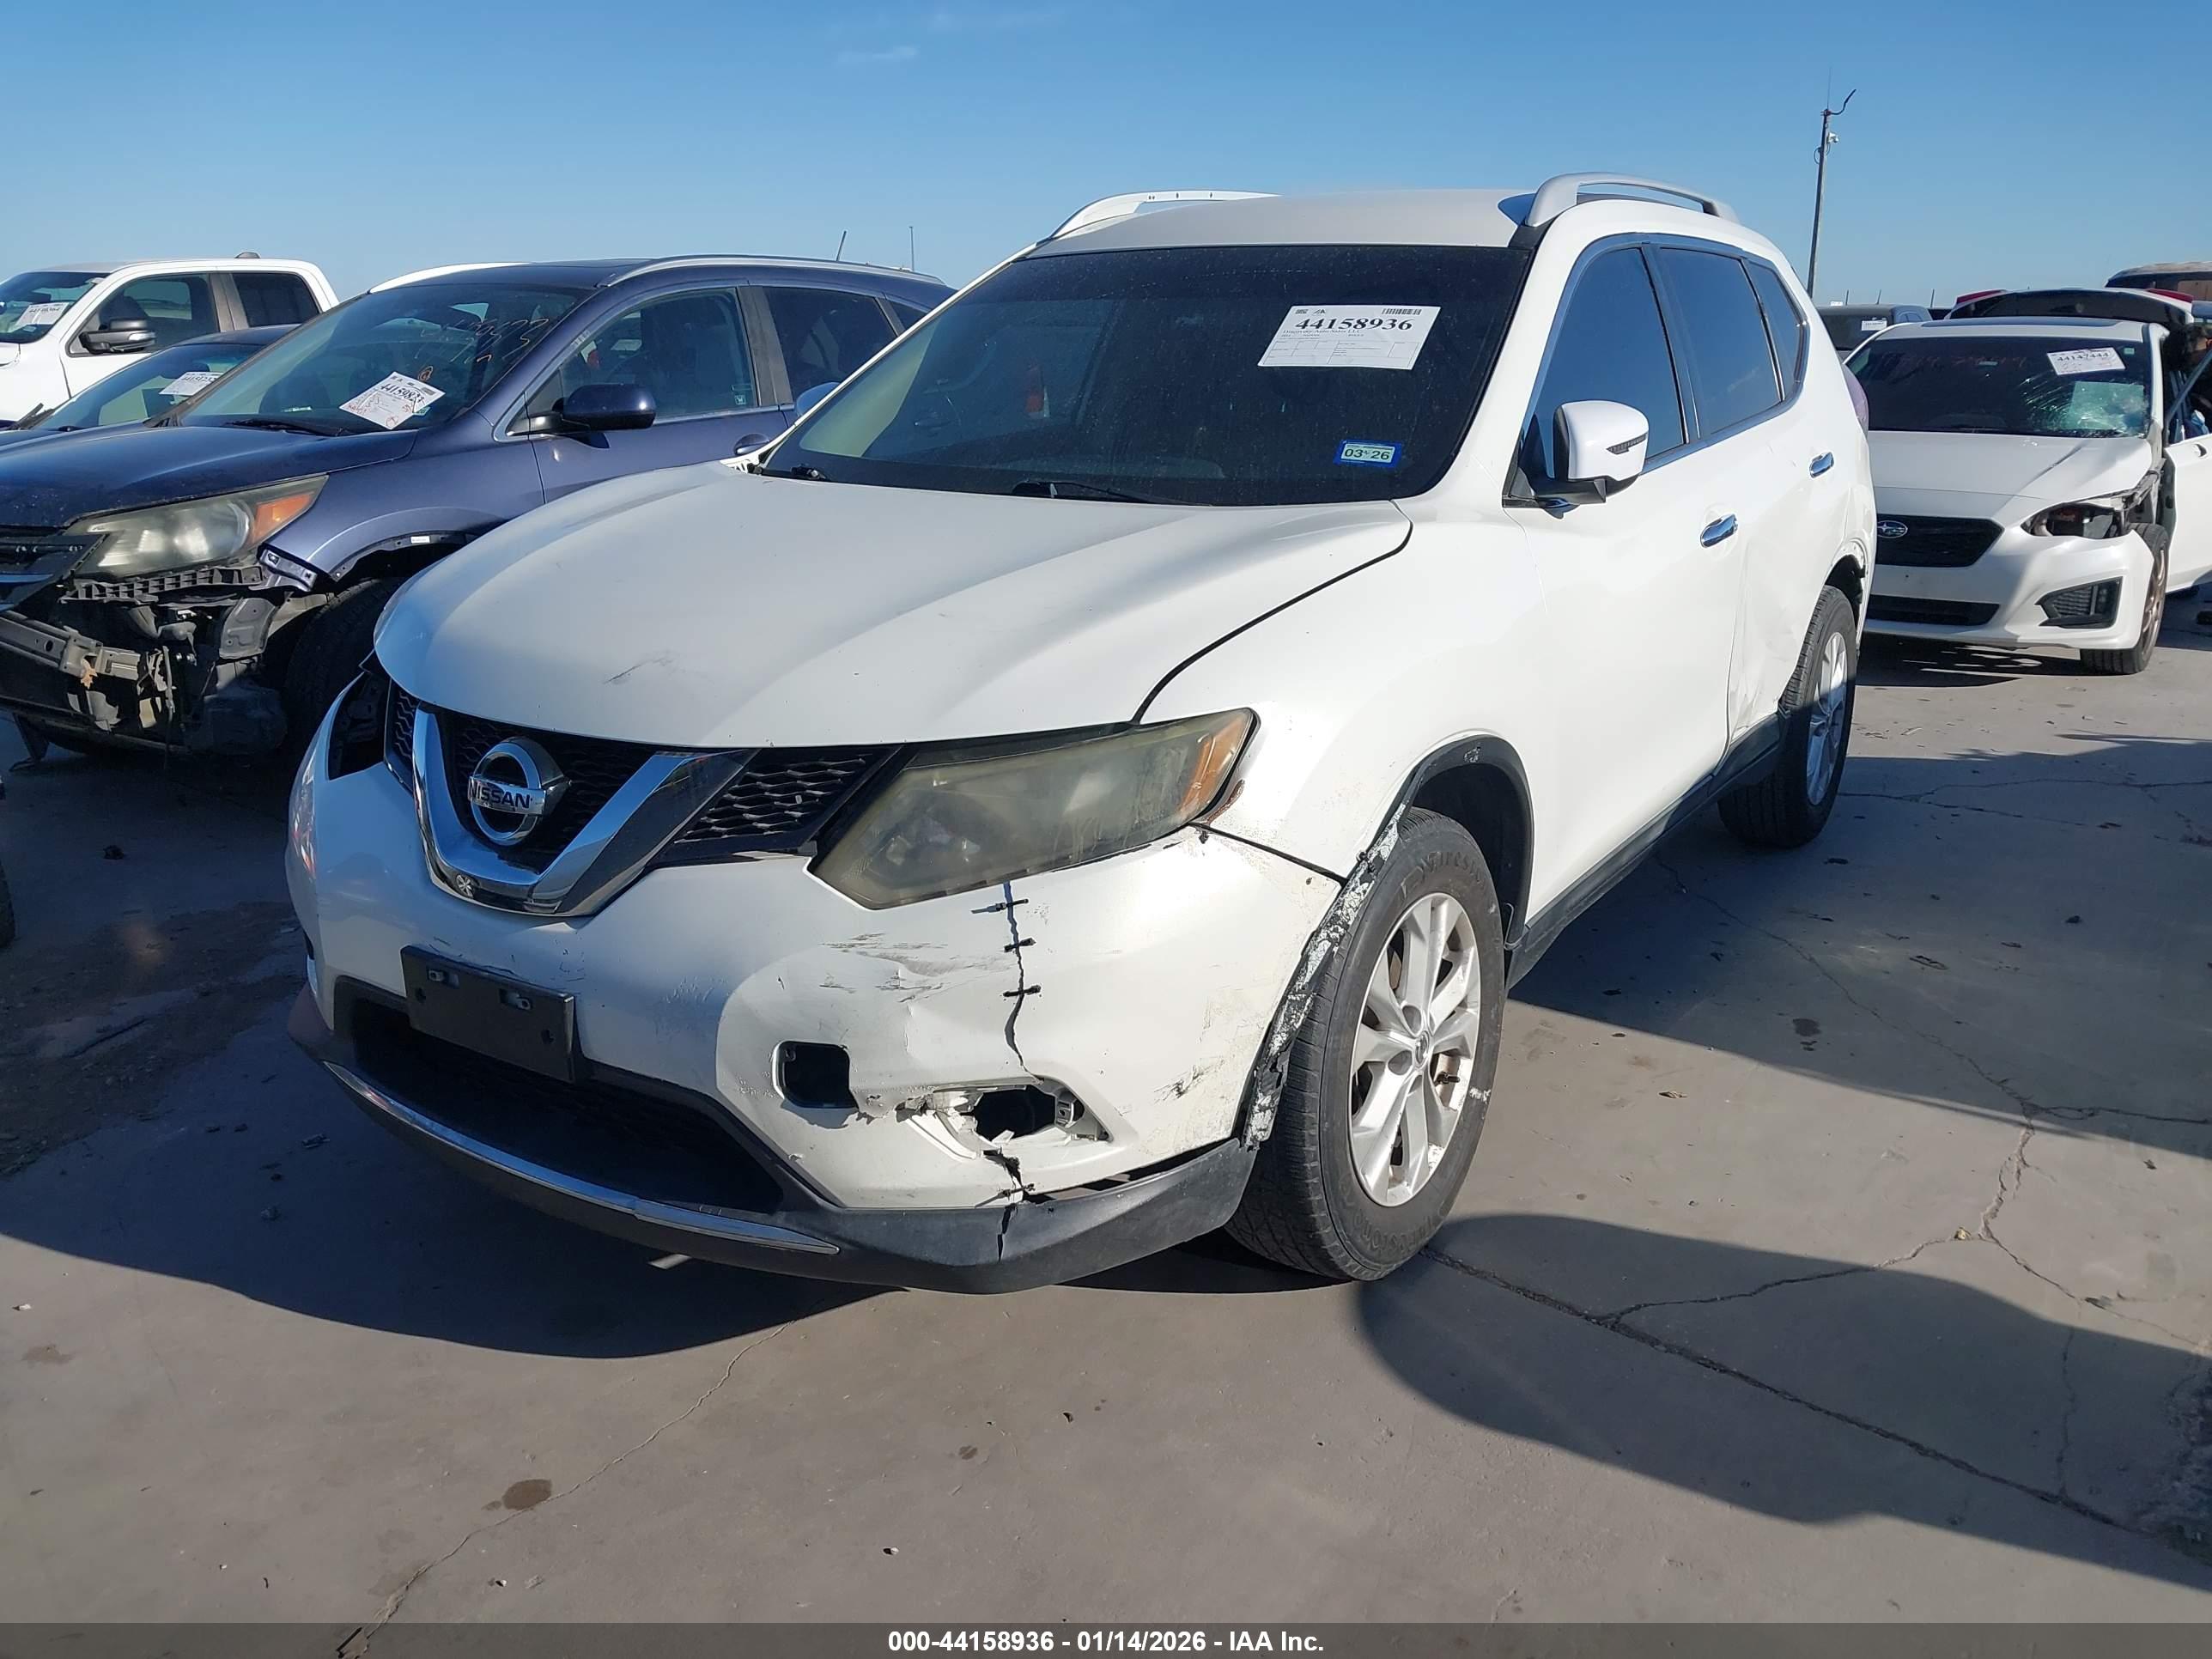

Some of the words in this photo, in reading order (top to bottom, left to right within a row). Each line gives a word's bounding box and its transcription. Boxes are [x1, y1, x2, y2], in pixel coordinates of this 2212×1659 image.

[1295, 318, 1414, 330] 44158936
[1345, 448, 1363, 458] 03
[1370, 450, 1390, 459] 26
[468, 777, 531, 809] NISSAN
